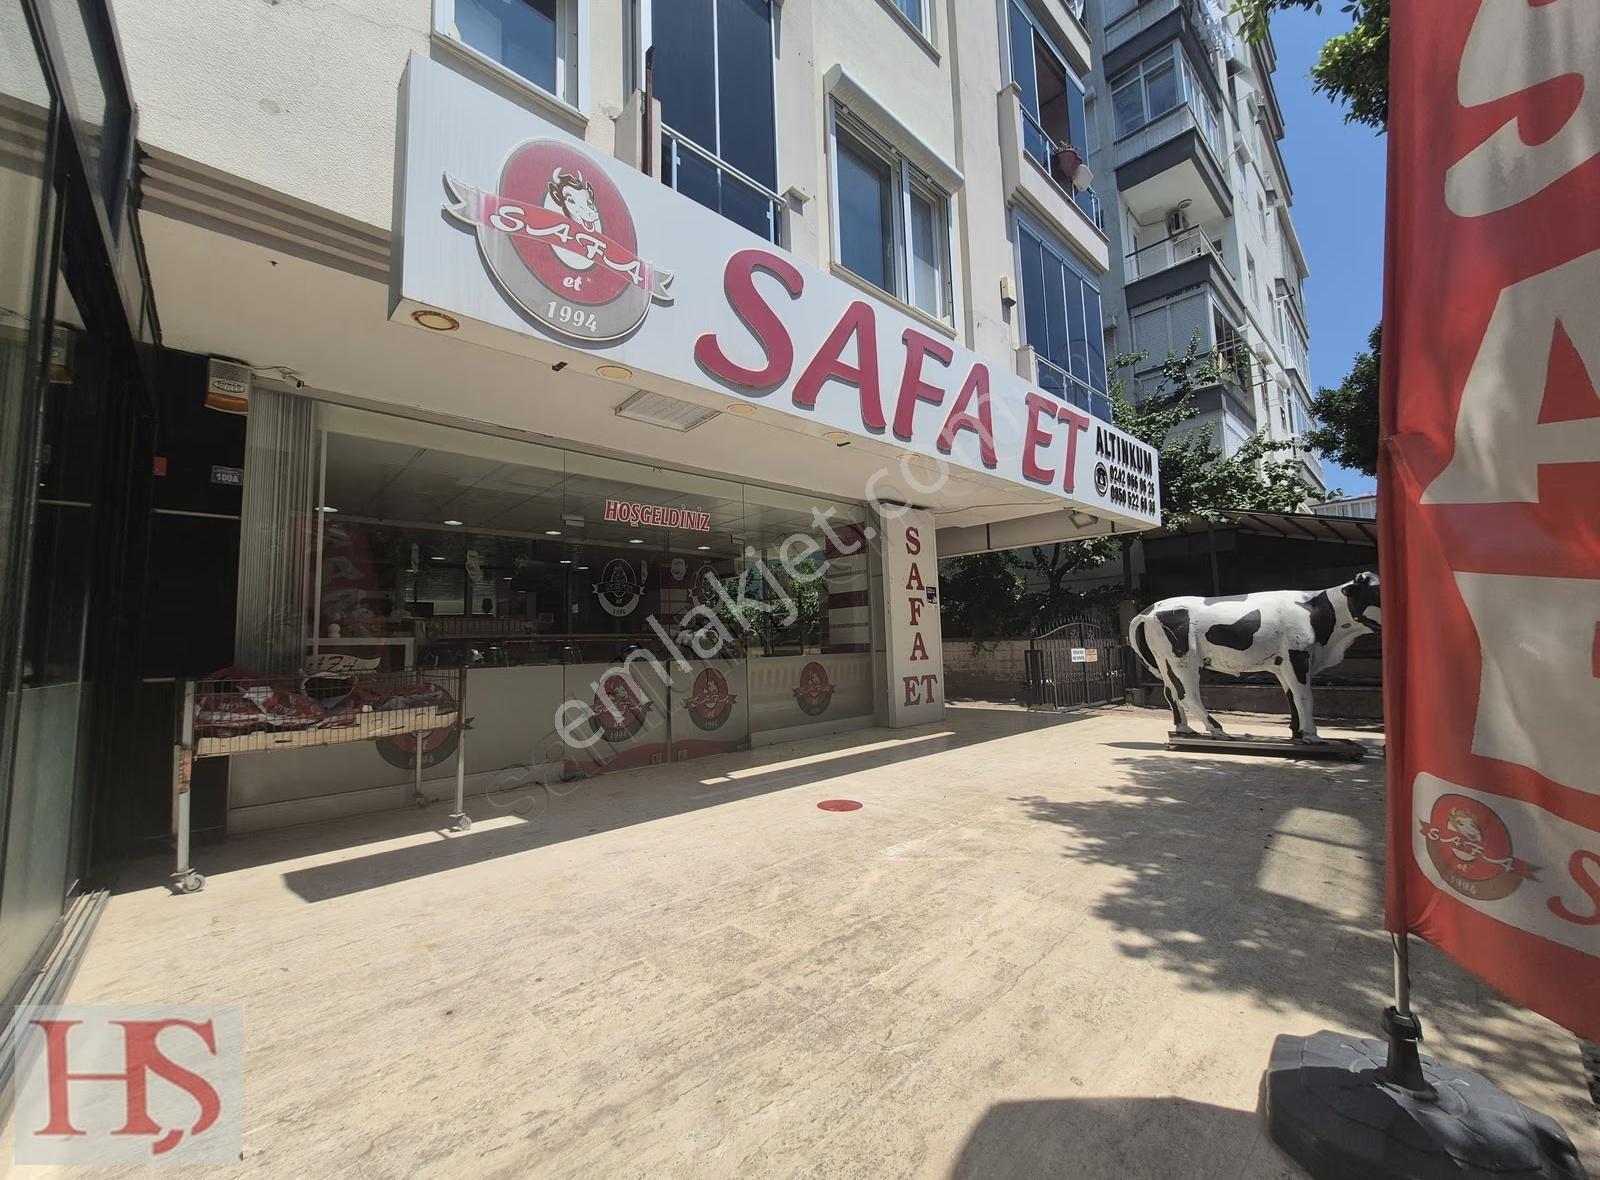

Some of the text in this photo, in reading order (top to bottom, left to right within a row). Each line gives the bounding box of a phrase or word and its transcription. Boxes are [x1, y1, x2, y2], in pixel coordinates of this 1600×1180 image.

[489, 205, 644, 285] SAFA
[562, 275, 584, 292] et
[547, 301, 598, 332] 1994
[693, 248, 1090, 494] SAFA ET
[1096, 426, 1153, 478] ALTINKUM
[604, 499, 711, 531] HOŞGELDİNİZ
[905, 526, 929, 661] SAFA
[902, 674, 938, 707] ET
